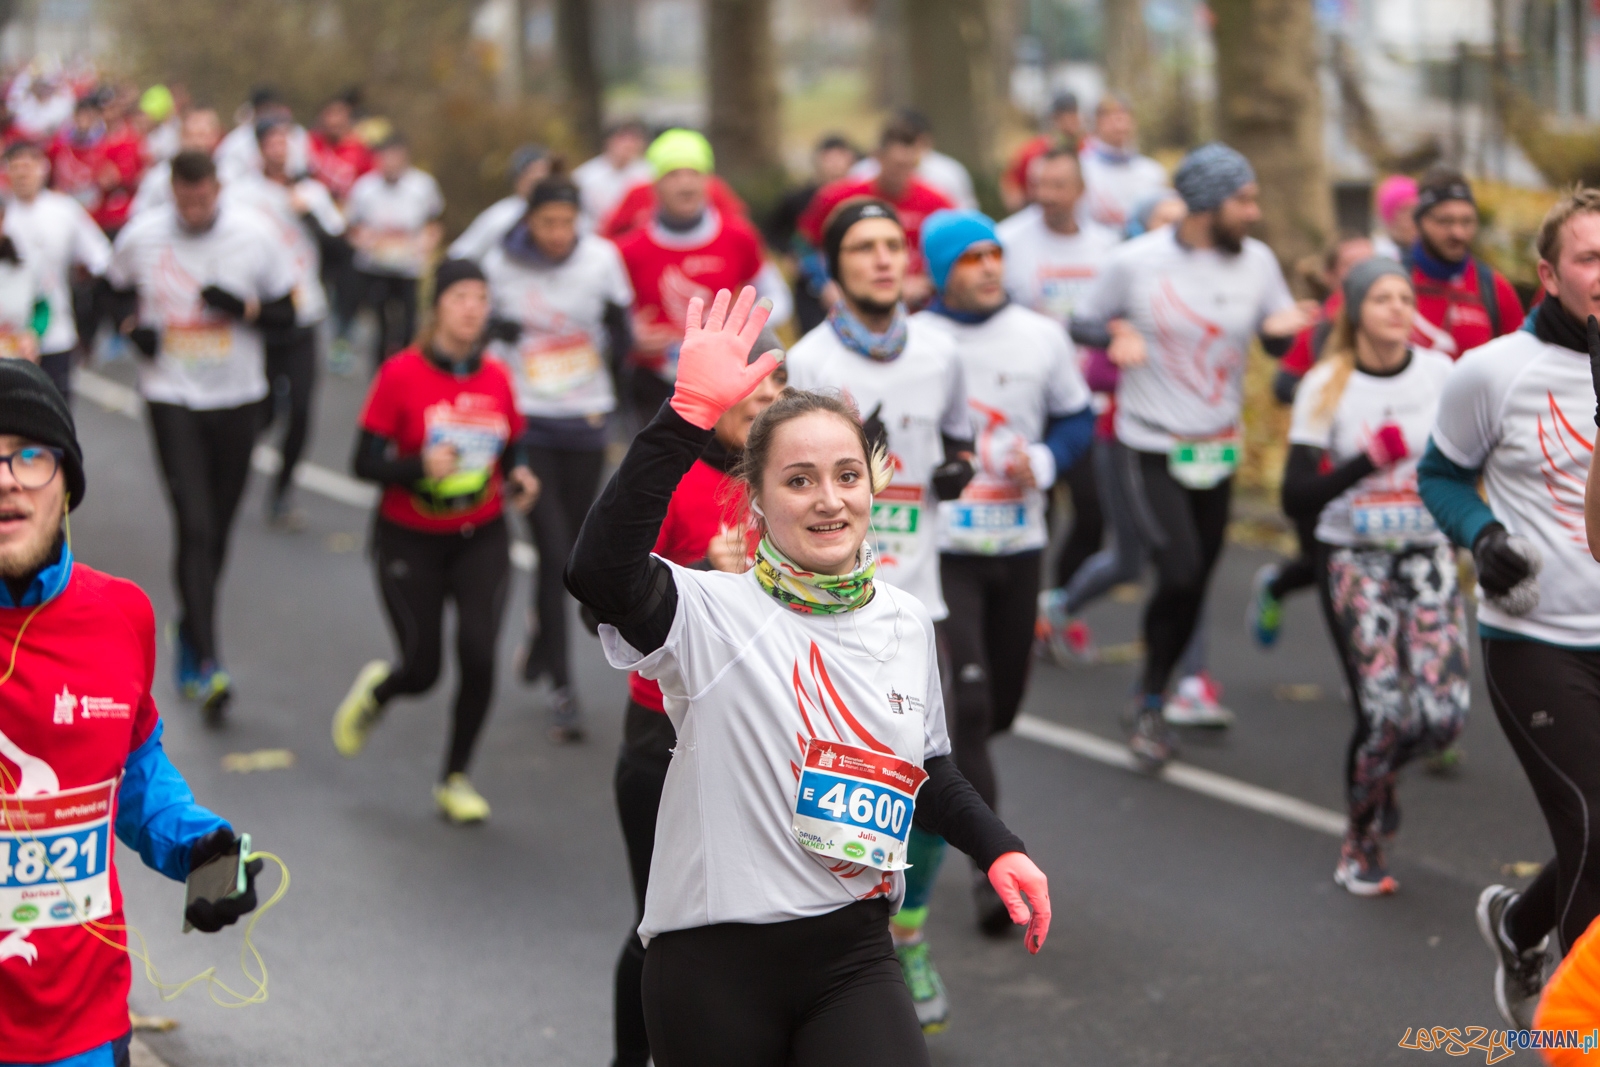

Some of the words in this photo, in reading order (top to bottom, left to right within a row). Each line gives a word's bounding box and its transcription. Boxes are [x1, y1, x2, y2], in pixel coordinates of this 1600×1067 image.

[882, 766, 915, 787] RunPoland.org
[54, 800, 108, 819] RunPoland.org
[802, 787, 815, 801] E
[817, 782, 906, 835] 4600
[857, 831, 877, 842] Julia
